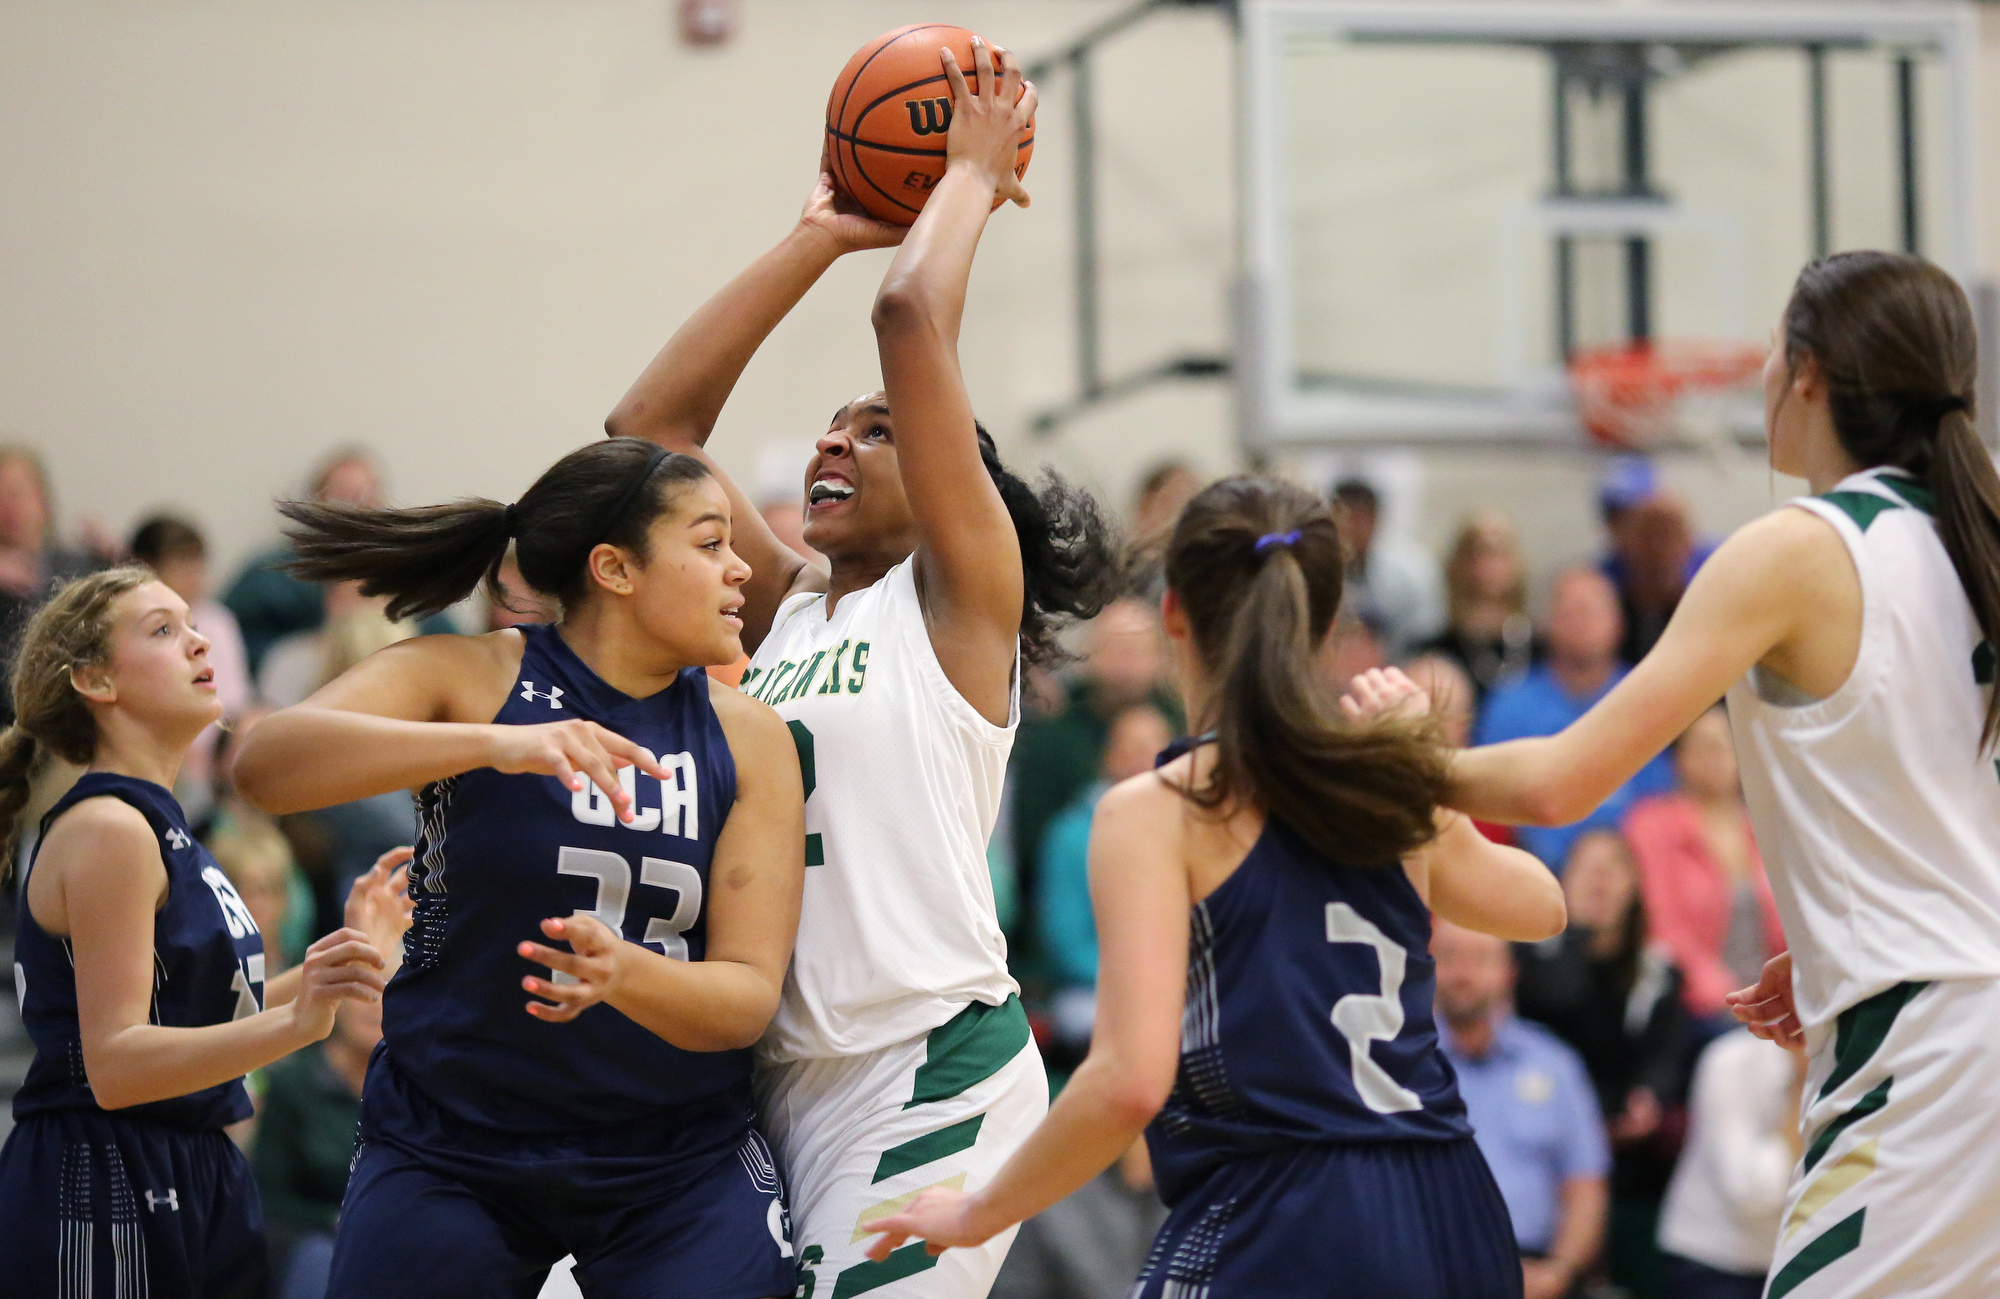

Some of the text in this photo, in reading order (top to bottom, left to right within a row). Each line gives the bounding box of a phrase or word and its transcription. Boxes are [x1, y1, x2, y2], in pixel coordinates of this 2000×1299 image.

[904, 96, 953, 137] W
[903, 171, 942, 190] EV
[570, 746, 700, 842] GCA
[550, 845, 703, 986] 33
[1325, 901, 1424, 1114] 2
